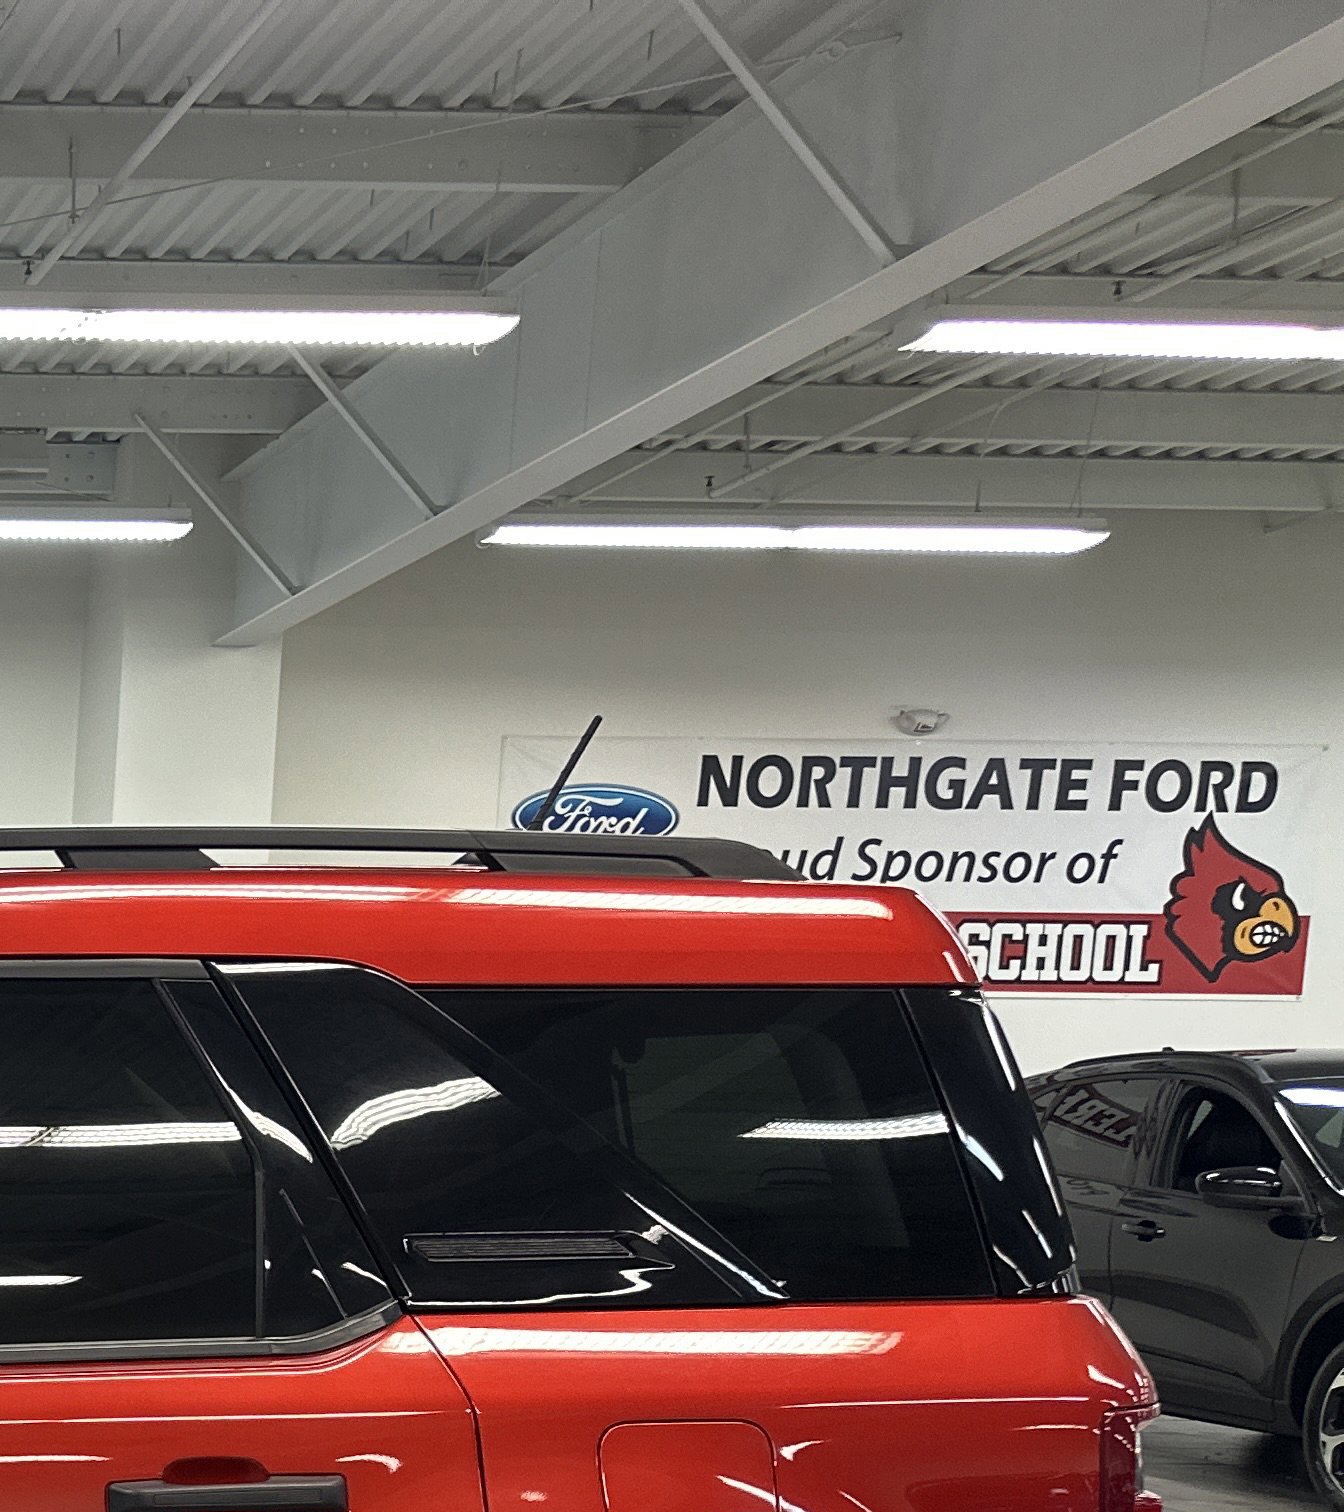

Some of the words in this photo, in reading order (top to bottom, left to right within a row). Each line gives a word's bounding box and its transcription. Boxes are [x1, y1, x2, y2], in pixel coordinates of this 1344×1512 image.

[696, 754, 1093, 811] NORTHGATE
[1107, 759, 1279, 813] FORD
[543, 794, 649, 836] Ford
[850, 837, 1058, 884] Sponsor
[1065, 838, 1124, 884] of
[957, 921, 1163, 985] SCHOOL
